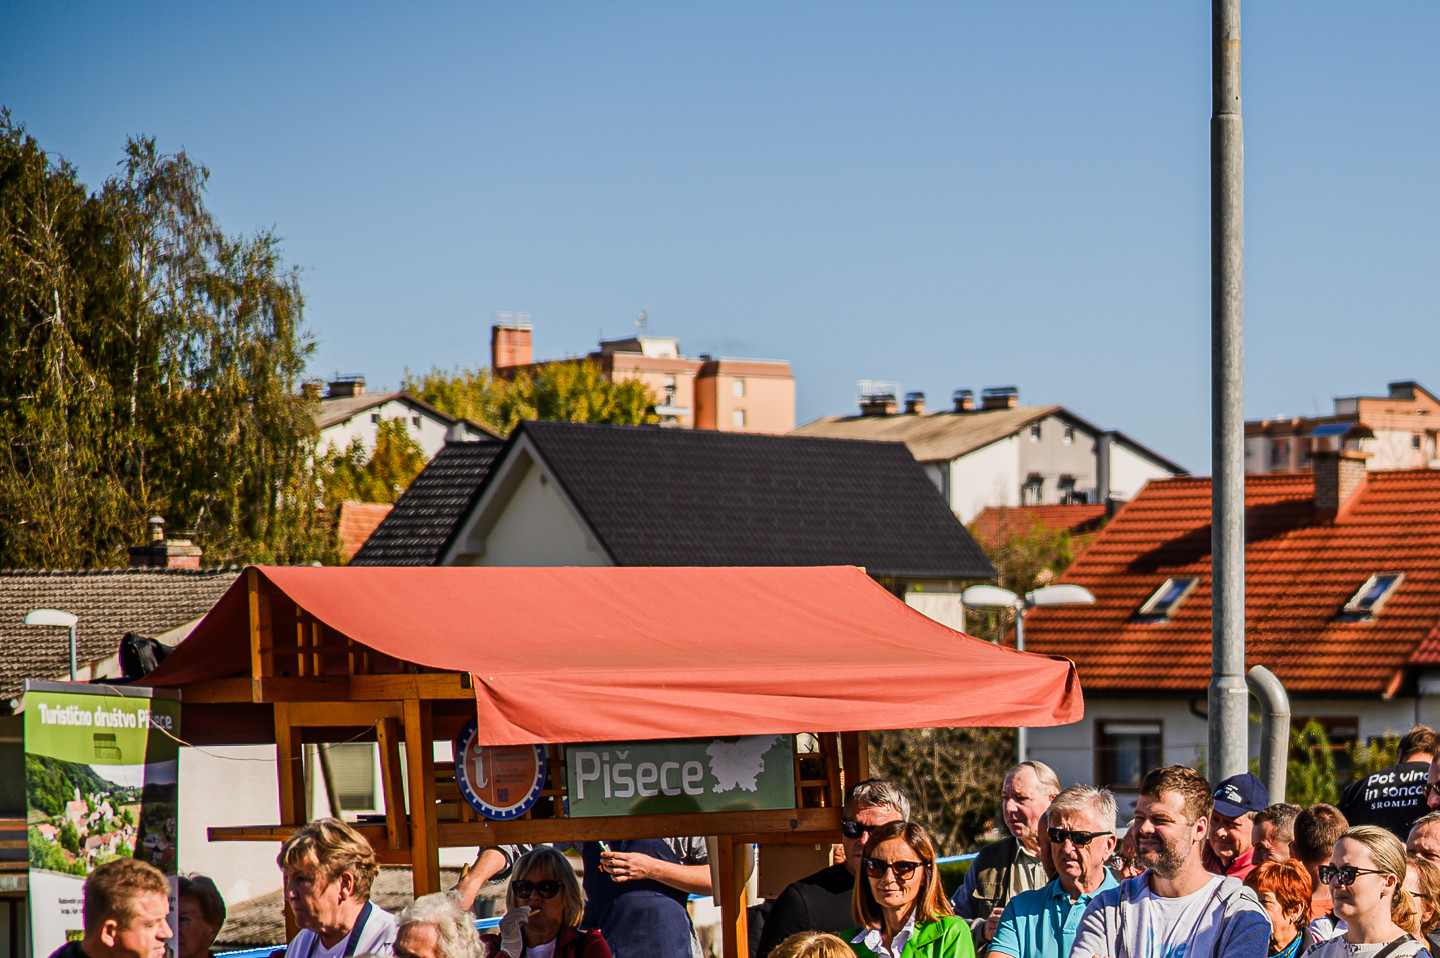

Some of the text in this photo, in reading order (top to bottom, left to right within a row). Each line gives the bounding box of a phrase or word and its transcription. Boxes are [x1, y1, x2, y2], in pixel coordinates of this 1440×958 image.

[38, 703, 92, 727] Turistično
[94, 706, 136, 729] društvo
[575, 750, 704, 799] Pišece
[1367, 772, 1396, 787] Pot
[1364, 788, 1379, 801] in
[1370, 799, 1419, 810] SROMLJE
